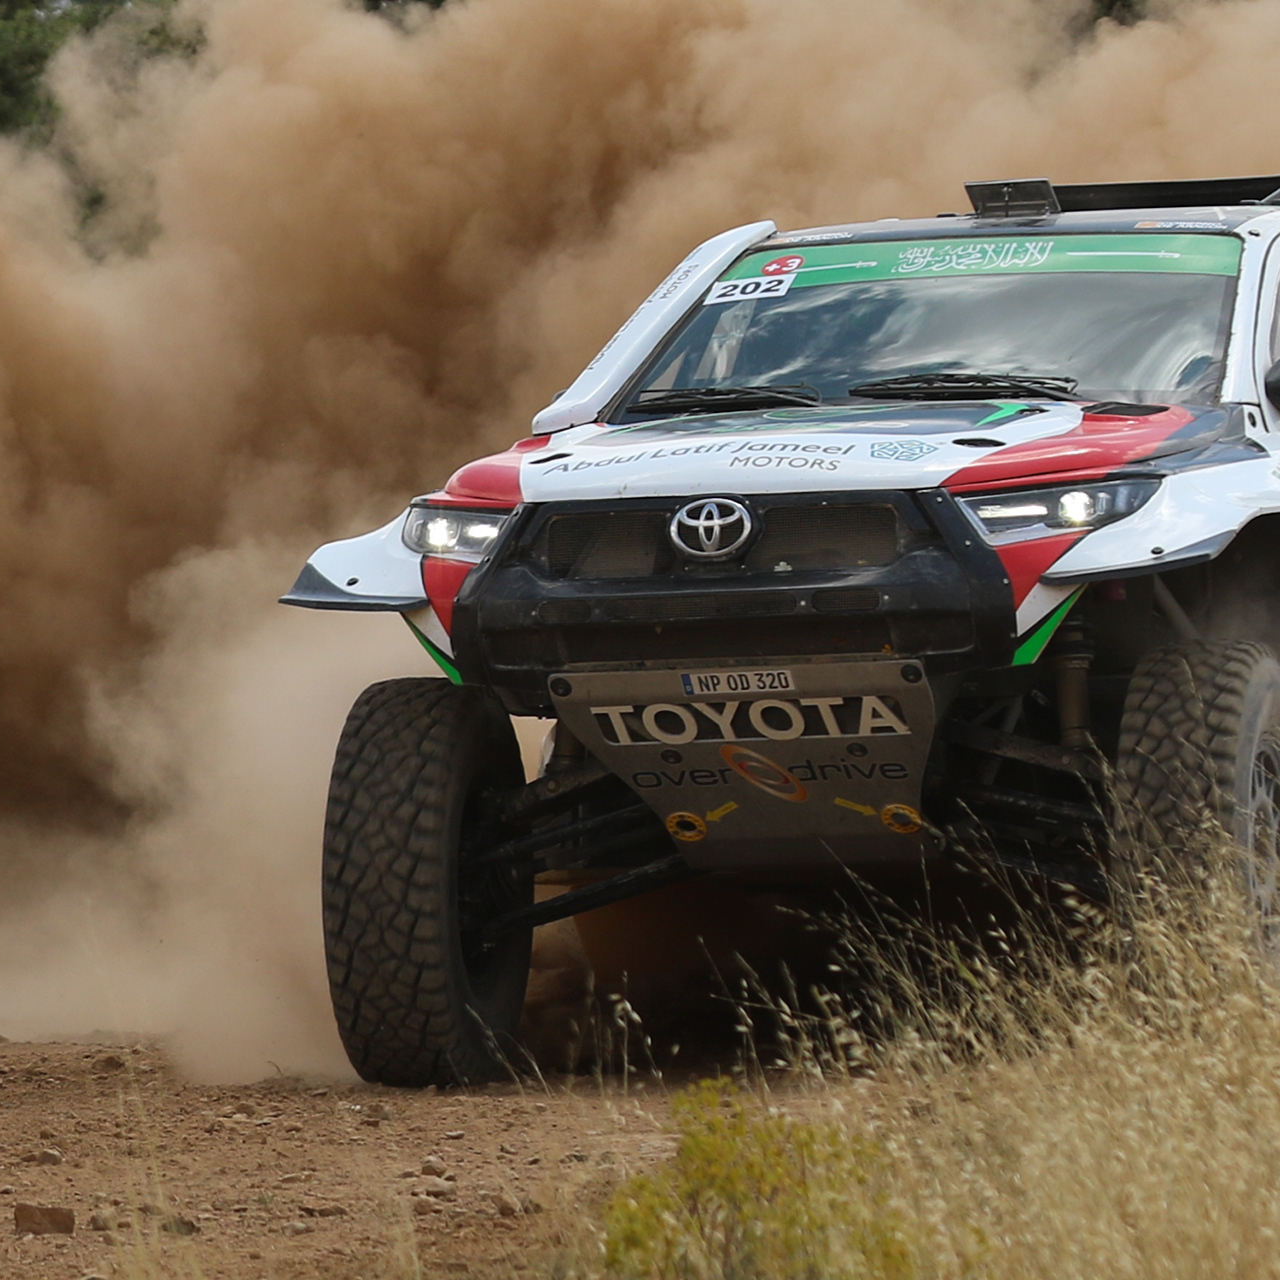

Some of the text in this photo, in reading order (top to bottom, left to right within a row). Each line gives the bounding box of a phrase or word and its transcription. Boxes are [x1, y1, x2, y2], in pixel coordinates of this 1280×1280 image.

[764, 258, 802, 273] +3
[714, 278, 786, 299] 202
[541, 441, 857, 477] Abdul Latif Jameel
[729, 456, 841, 472] MOTORS
[697, 674, 721, 693] NP
[753, 671, 790, 690] 320
[589, 695, 913, 746] TOYOTA
[631, 758, 910, 789] over drive
